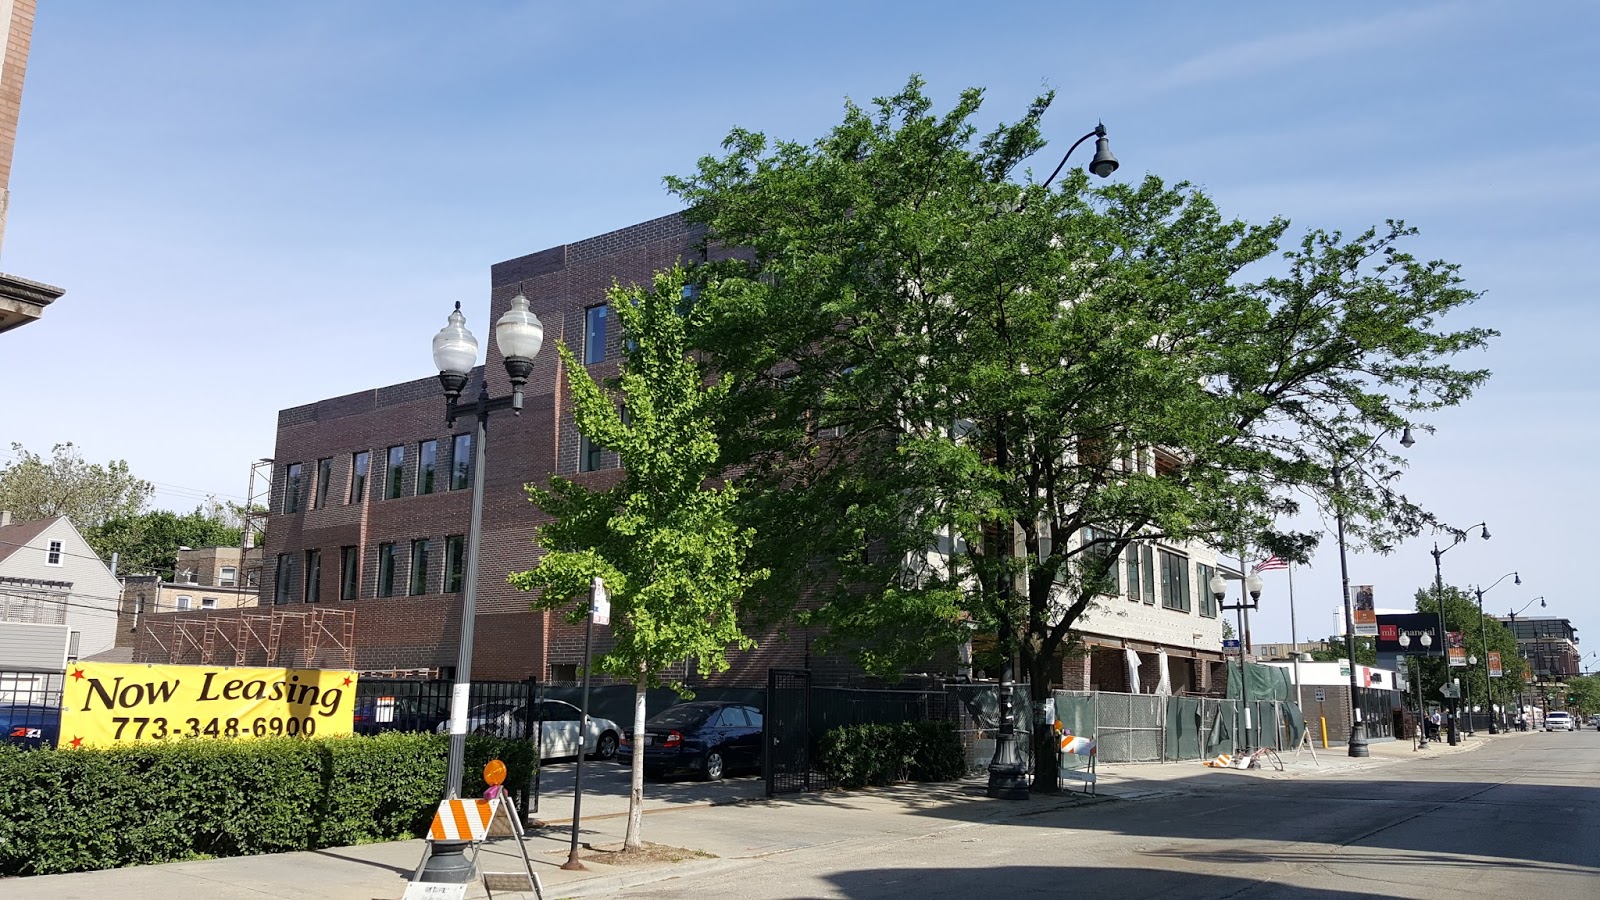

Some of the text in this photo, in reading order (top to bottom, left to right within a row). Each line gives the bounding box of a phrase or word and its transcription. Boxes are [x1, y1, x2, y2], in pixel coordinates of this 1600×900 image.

[1382, 628, 1396, 636] mb
[80, 672, 343, 717] Now Leasing
[112, 716, 316, 740] 773-348-6900
